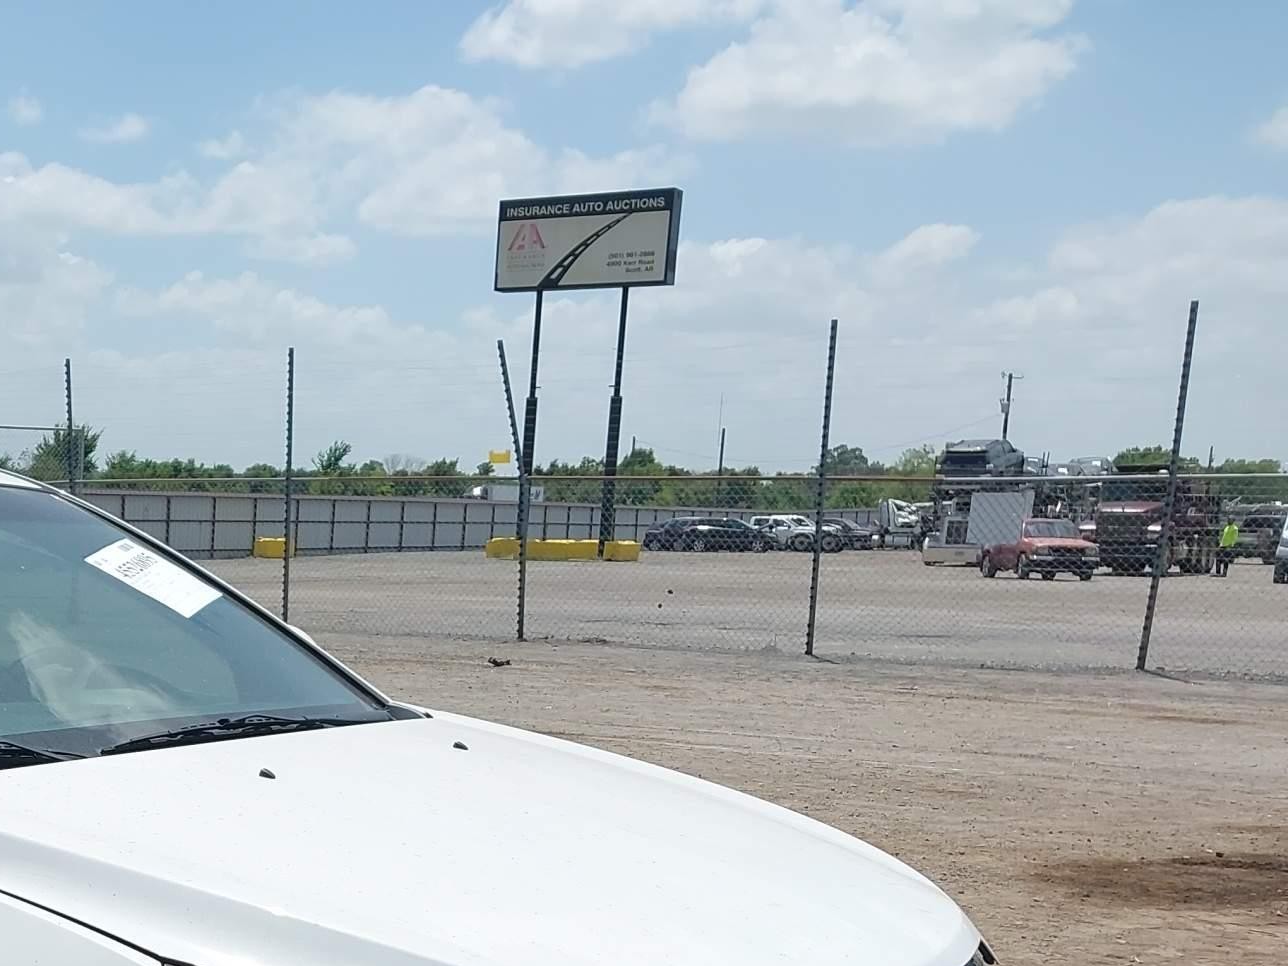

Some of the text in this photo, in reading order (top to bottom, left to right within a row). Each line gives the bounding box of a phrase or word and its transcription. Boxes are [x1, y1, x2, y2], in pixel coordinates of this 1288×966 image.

[507, 196, 665, 217] INSURANCE AUTO AUCTIONS
